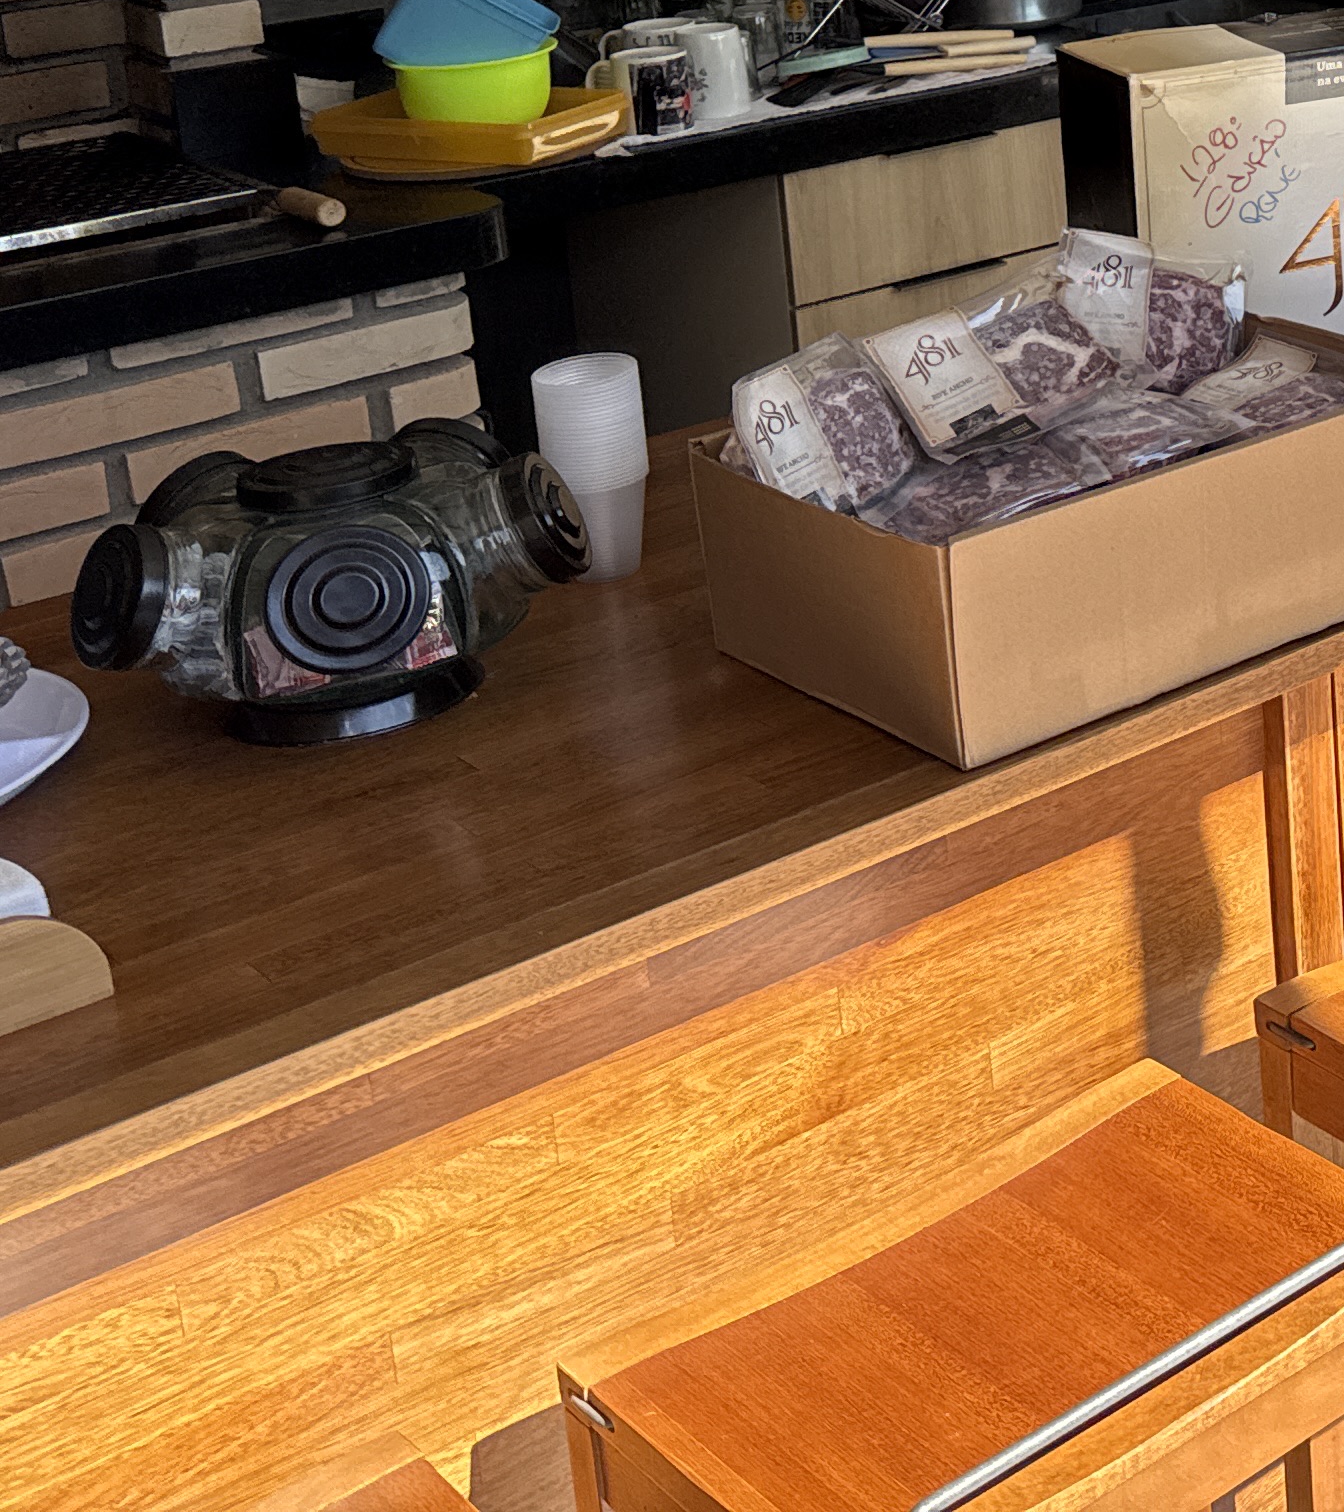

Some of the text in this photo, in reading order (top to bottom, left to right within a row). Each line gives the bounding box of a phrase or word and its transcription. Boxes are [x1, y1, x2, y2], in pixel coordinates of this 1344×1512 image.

[1316, 61, 1342, 72] Uma
[1317, 77, 1331, 87] na
[905, 334, 963, 386] 481
[755, 399, 801, 456] 481
